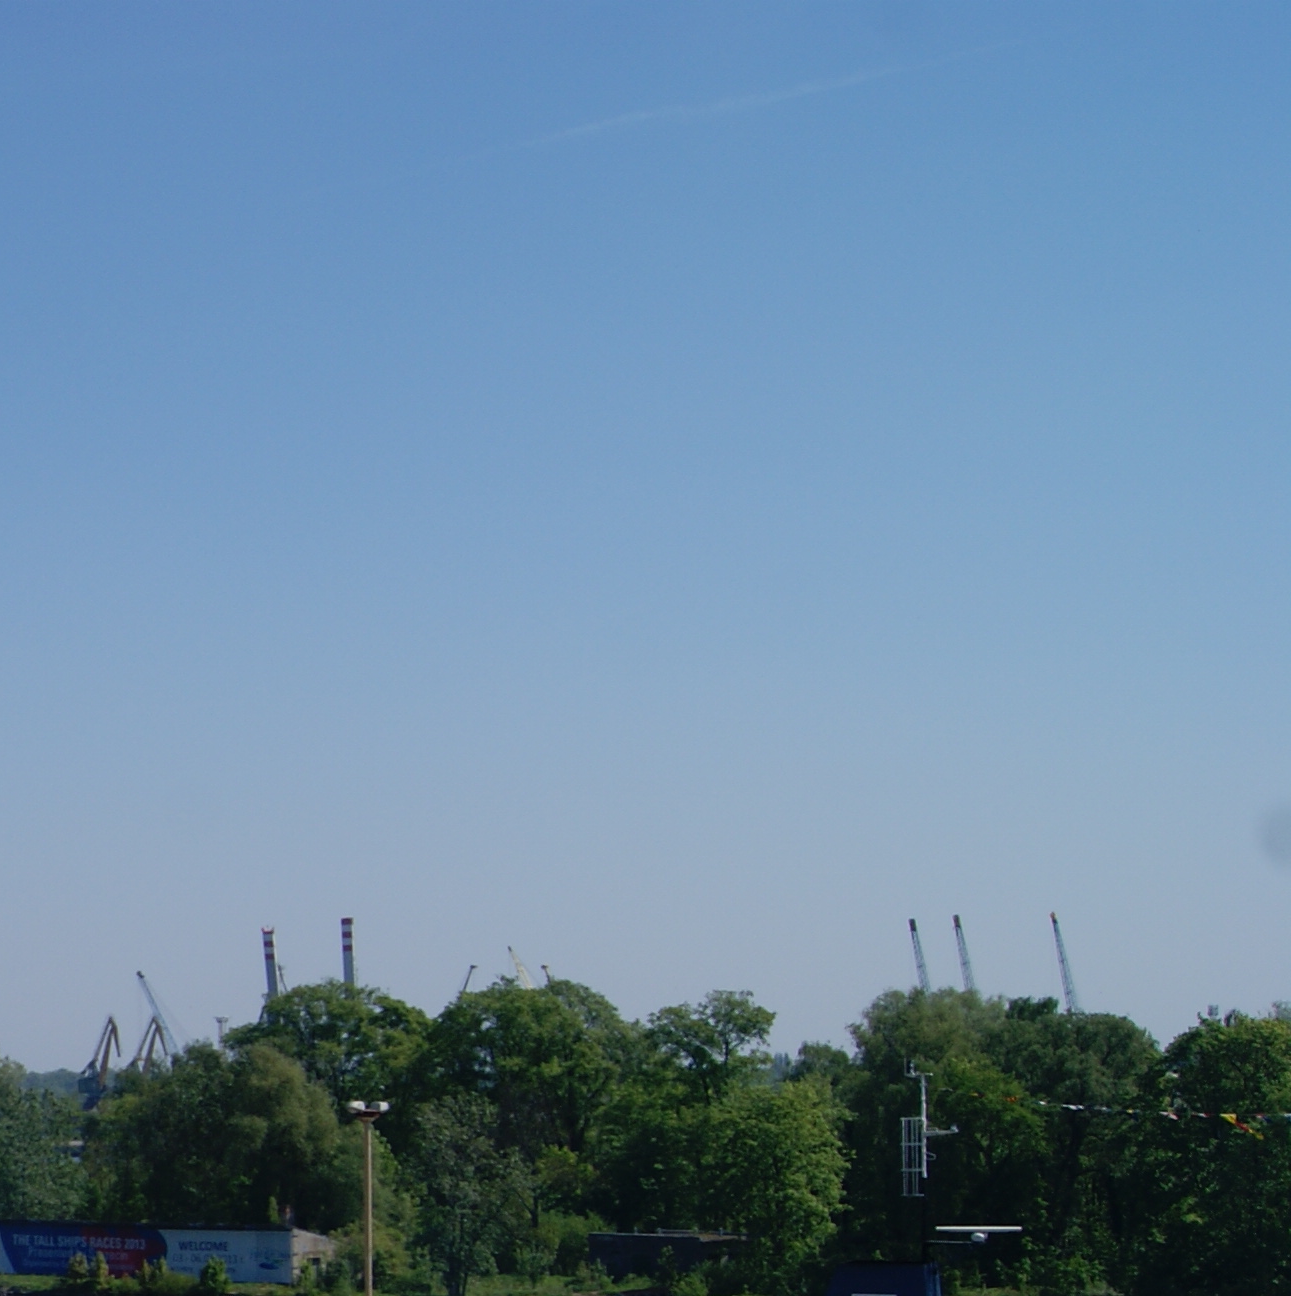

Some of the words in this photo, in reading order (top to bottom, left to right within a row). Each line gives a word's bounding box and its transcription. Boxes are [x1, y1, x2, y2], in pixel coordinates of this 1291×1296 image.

[12, 1234, 29, 1246] THE
[34, 1235, 54, 1247] TALL
[58, 1236, 87, 1247] SHIPS
[89, 1237, 122, 1249] RACES
[178, 1241, 228, 1251] WELCOME
